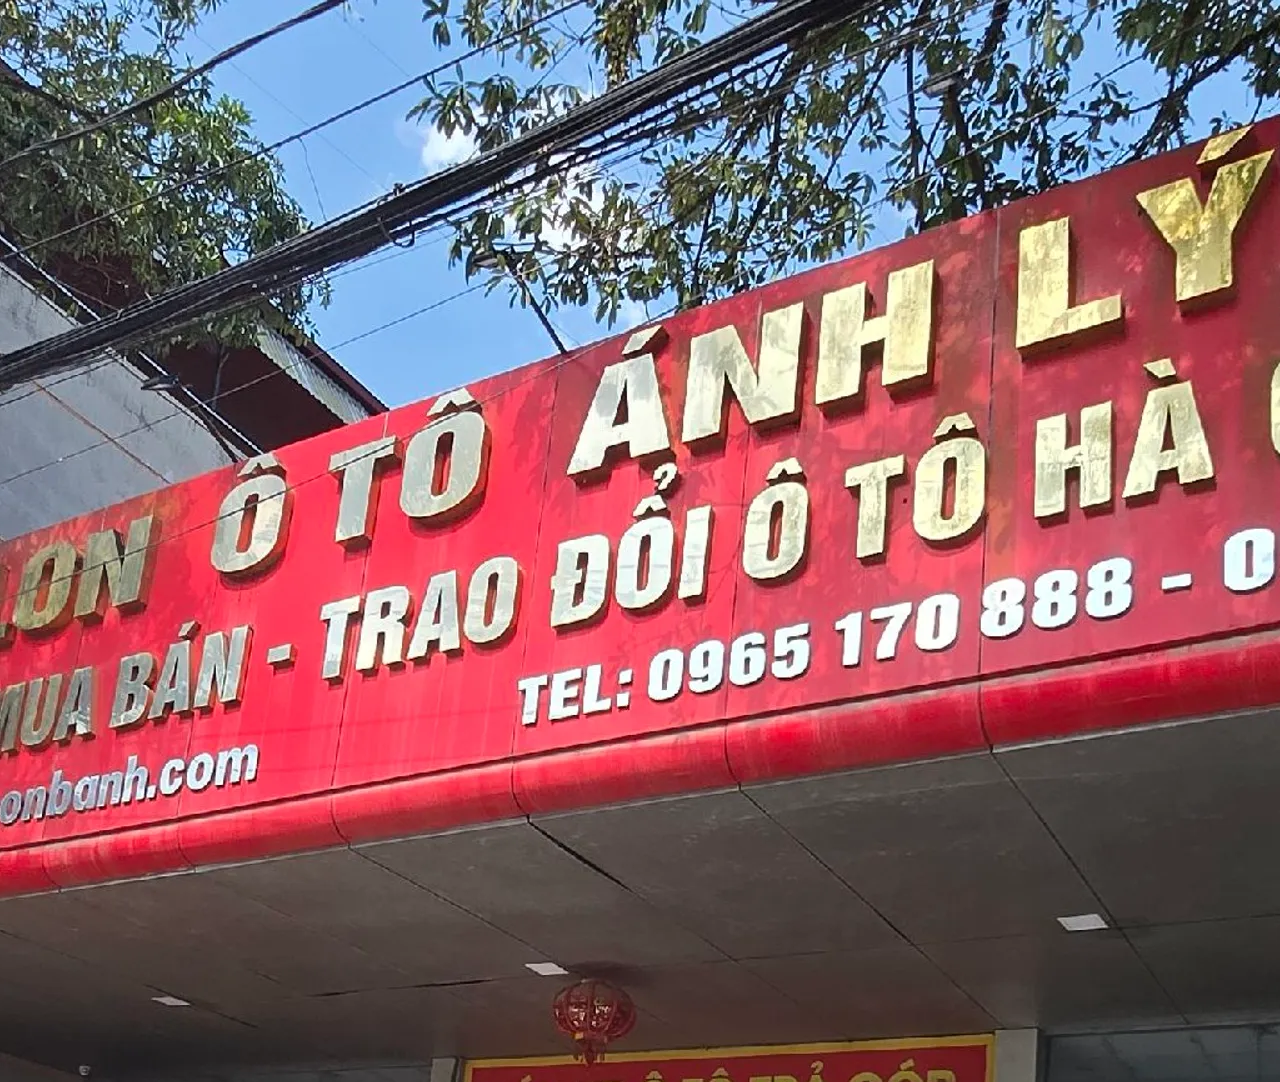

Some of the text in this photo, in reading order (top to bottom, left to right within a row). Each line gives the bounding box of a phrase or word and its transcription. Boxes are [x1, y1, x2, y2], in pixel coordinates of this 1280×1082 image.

[211, 455, 291, 580] Ô
[328, 387, 490, 548] TÔ
[566, 257, 940, 480] ÁNH
[1014, 124, 1276, 356] LÝ
[110, 619, 253, 729] BÁN
[266, 643, 295, 669] -
[319, 554, 521, 683] TRAO
[549, 461, 714, 630] ĐỔI
[742, 456, 811, 584] Ô
[844, 410, 988, 563] TÔ
[1032, 357, 1217, 526] HÀ
[519, 665, 632, 727] TEL:
[648, 623, 811, 702] 0965
[835, 592, 961, 670] 170
[980, 556, 1134, 640] 888
[1160, 572, 1194, 593] -
